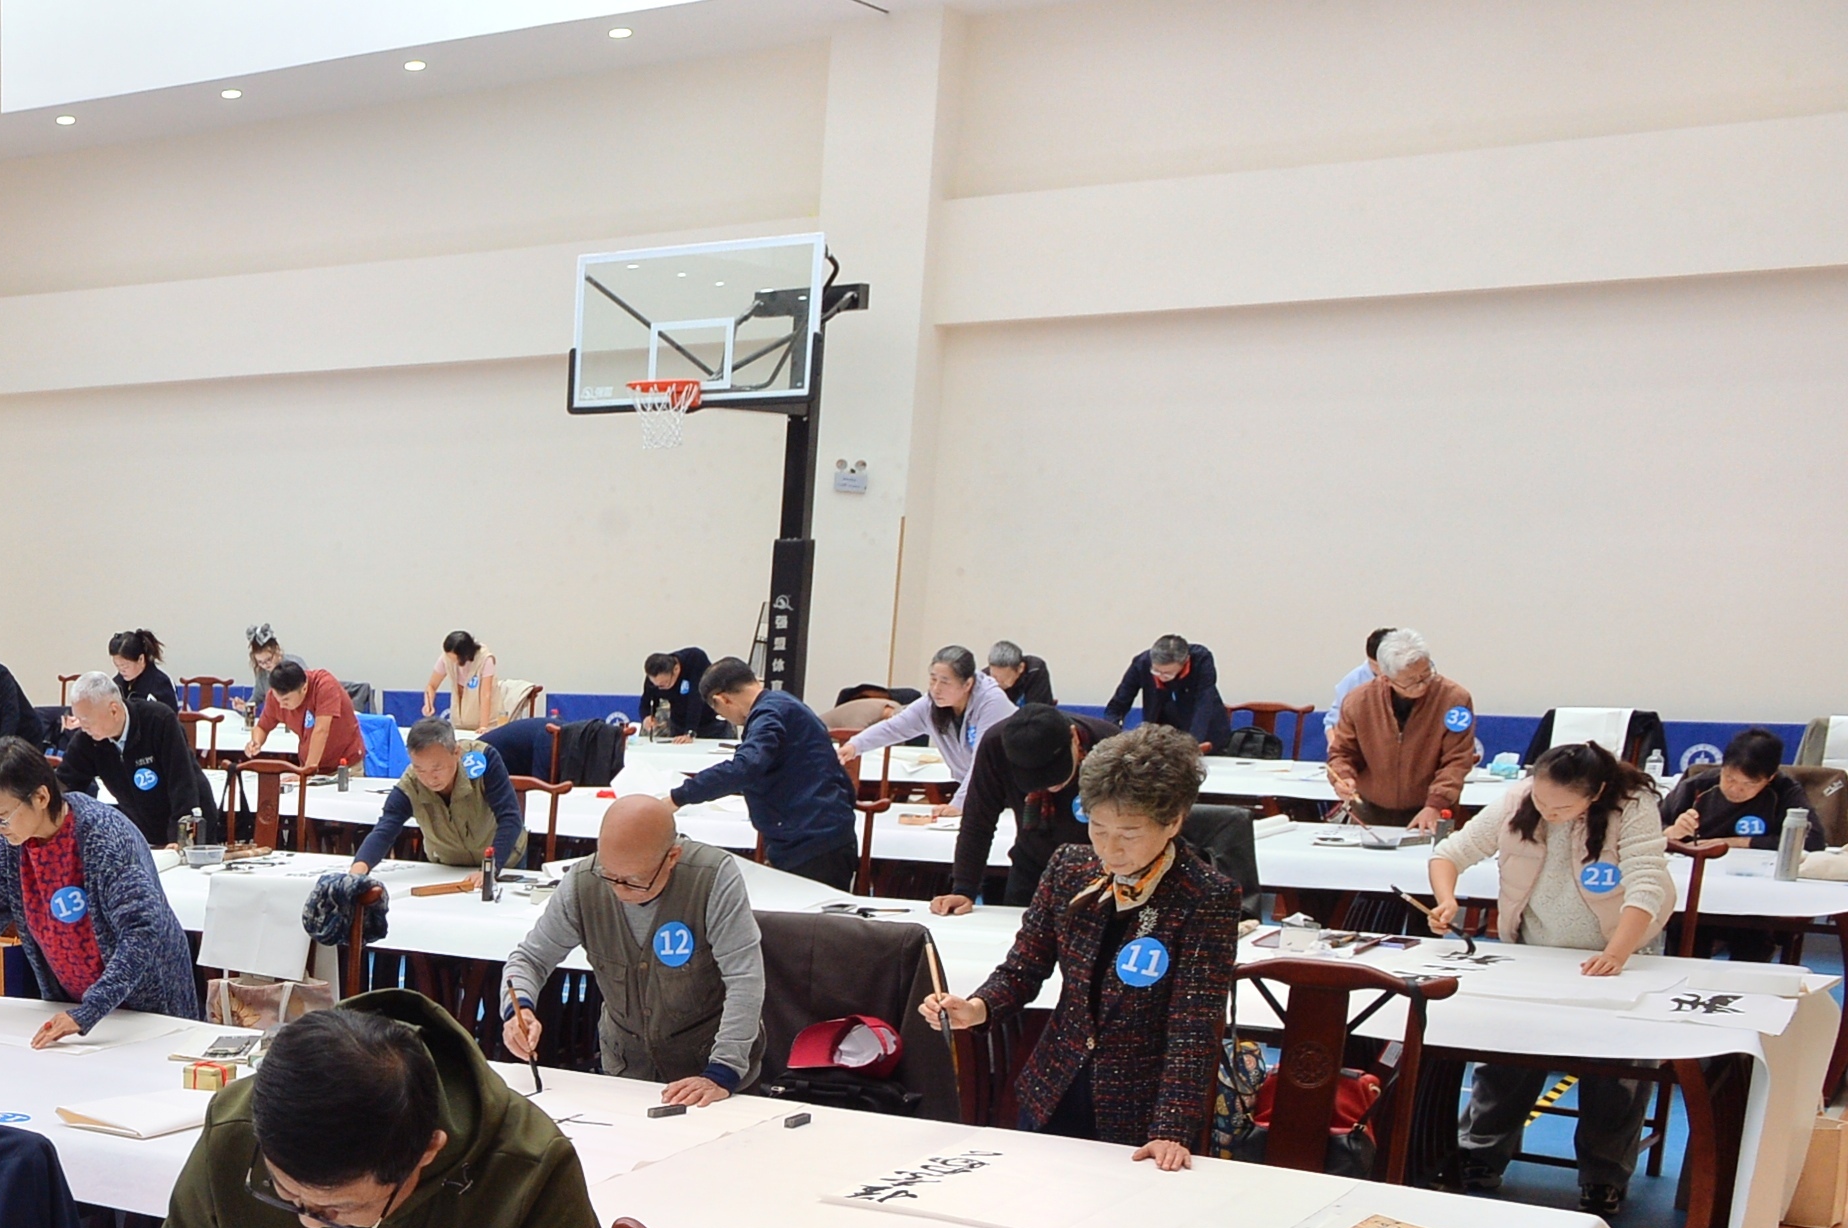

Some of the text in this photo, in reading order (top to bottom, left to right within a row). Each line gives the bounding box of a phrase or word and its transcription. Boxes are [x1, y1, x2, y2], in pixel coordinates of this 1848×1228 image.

[1446, 709, 1470, 727] 32
[463, 754, 485, 776] 24
[136, 769, 156, 785] 25
[1738, 819, 1761, 834] 31
[1584, 868, 1615, 885] 21
[54, 891, 85, 917] 13
[660, 930, 690, 955] 12
[1121, 945, 1161, 977] 11
